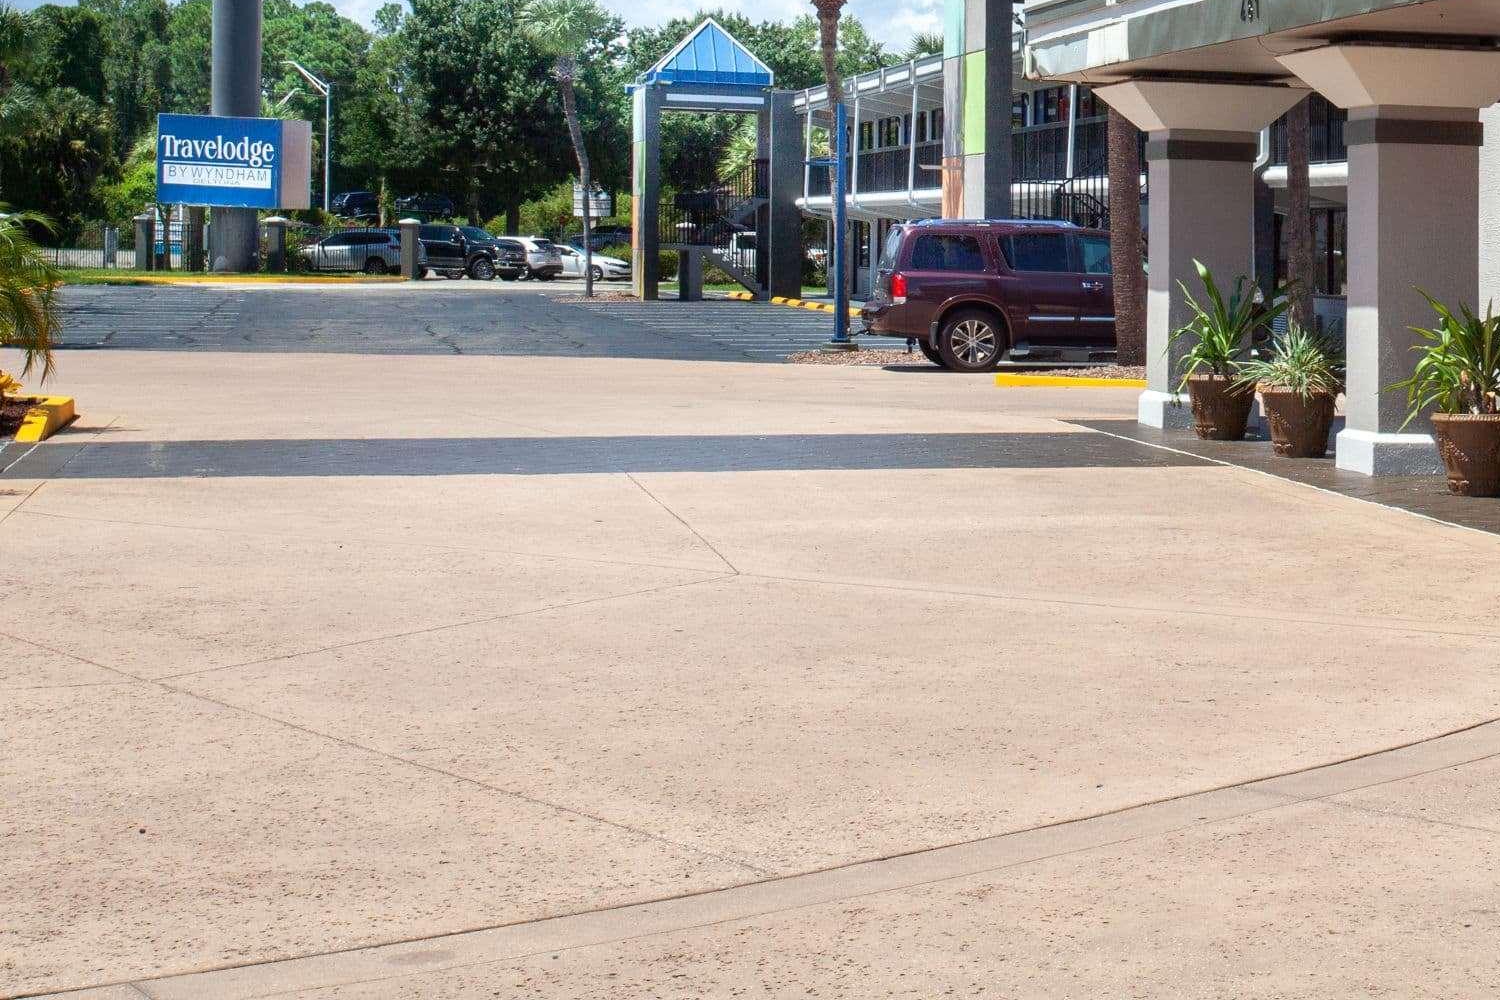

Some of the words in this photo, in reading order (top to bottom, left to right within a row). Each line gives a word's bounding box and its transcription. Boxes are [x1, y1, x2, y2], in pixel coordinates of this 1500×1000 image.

[160, 135, 275, 167] Travelodge
[168, 165, 188, 178] BY
[191, 167, 267, 182] WYNDHAM
